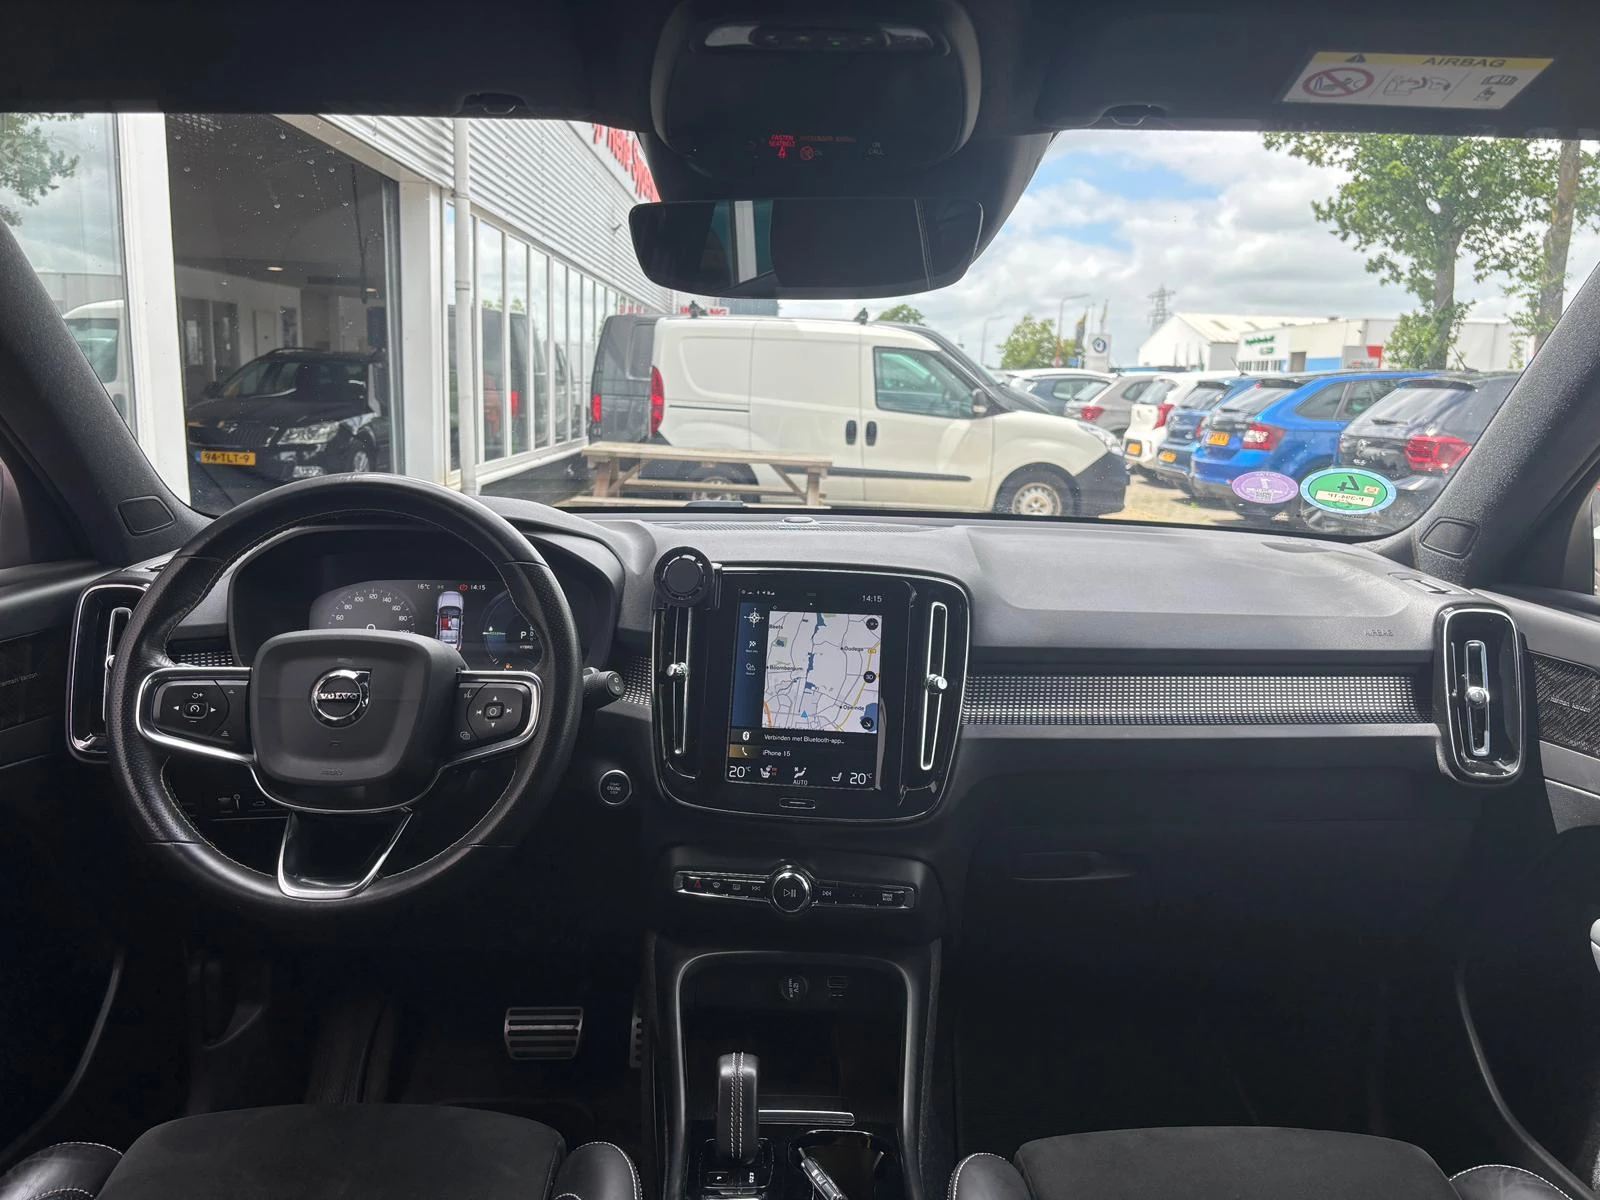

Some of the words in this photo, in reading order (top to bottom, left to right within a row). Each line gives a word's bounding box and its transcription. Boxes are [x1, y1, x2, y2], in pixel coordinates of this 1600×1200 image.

[1421, 57, 1506, 68] AIRBAG
[204, 453, 250, 463] 94-TLT-9
[862, 595, 882, 603] 14:15
[520, 631, 527, 640] P
[318, 692, 359, 700] VOLVO
